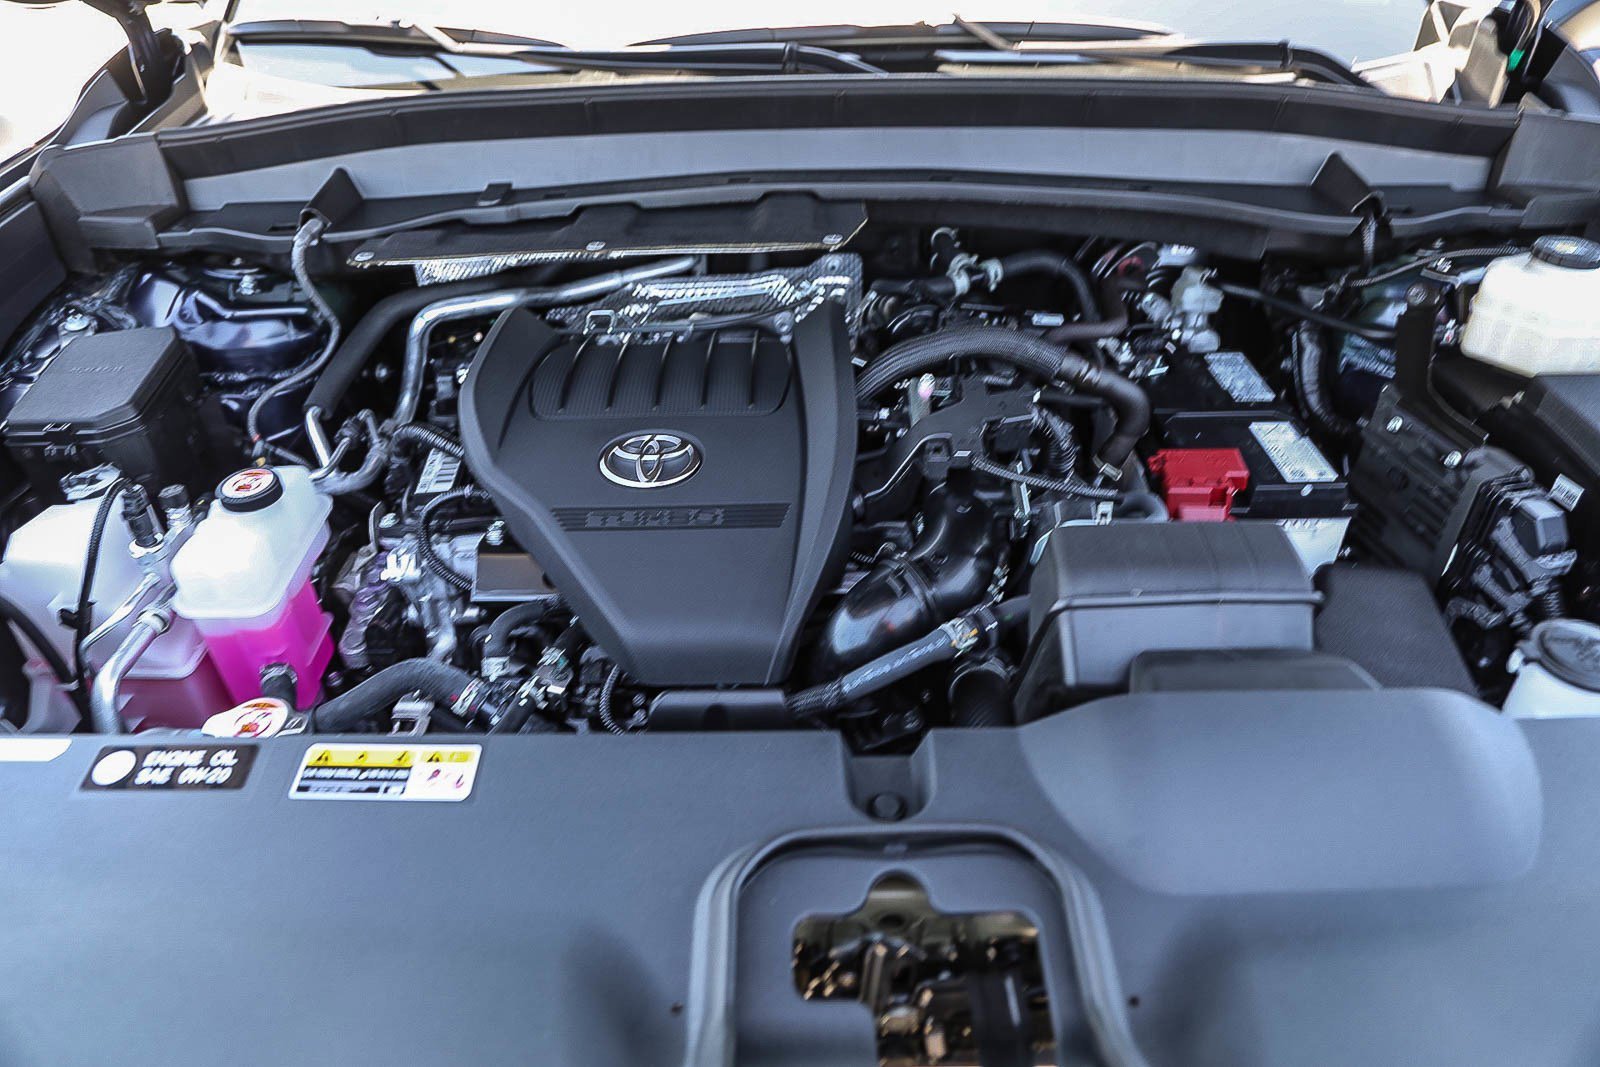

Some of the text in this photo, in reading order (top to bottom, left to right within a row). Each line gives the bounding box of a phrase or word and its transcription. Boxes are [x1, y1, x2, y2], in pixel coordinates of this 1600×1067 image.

[142, 749, 239, 767] ENGINE OIL
[134, 766, 175, 785] SAE
